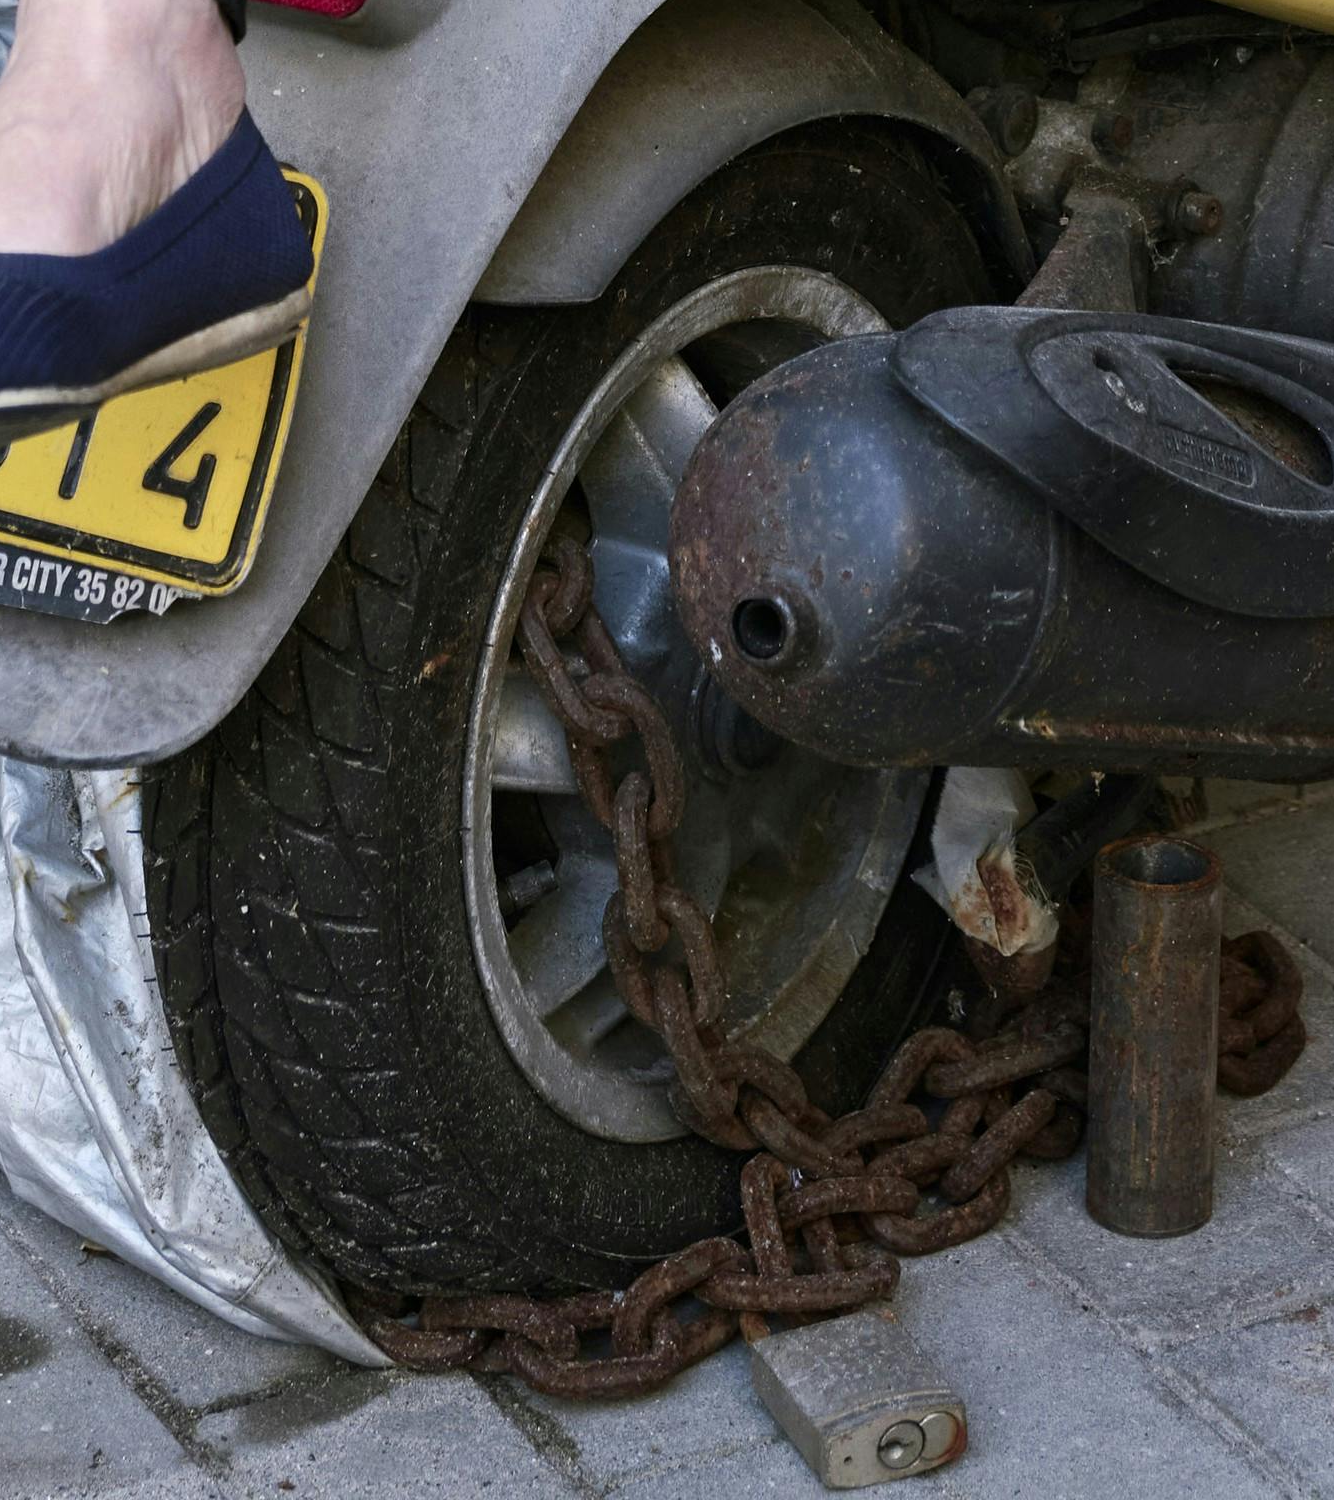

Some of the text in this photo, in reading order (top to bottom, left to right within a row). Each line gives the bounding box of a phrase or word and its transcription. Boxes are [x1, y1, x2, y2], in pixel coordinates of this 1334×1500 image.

[12, 556, 72, 597] CITY
[74, 568, 108, 605] 35
[111, 575, 145, 610] 82
